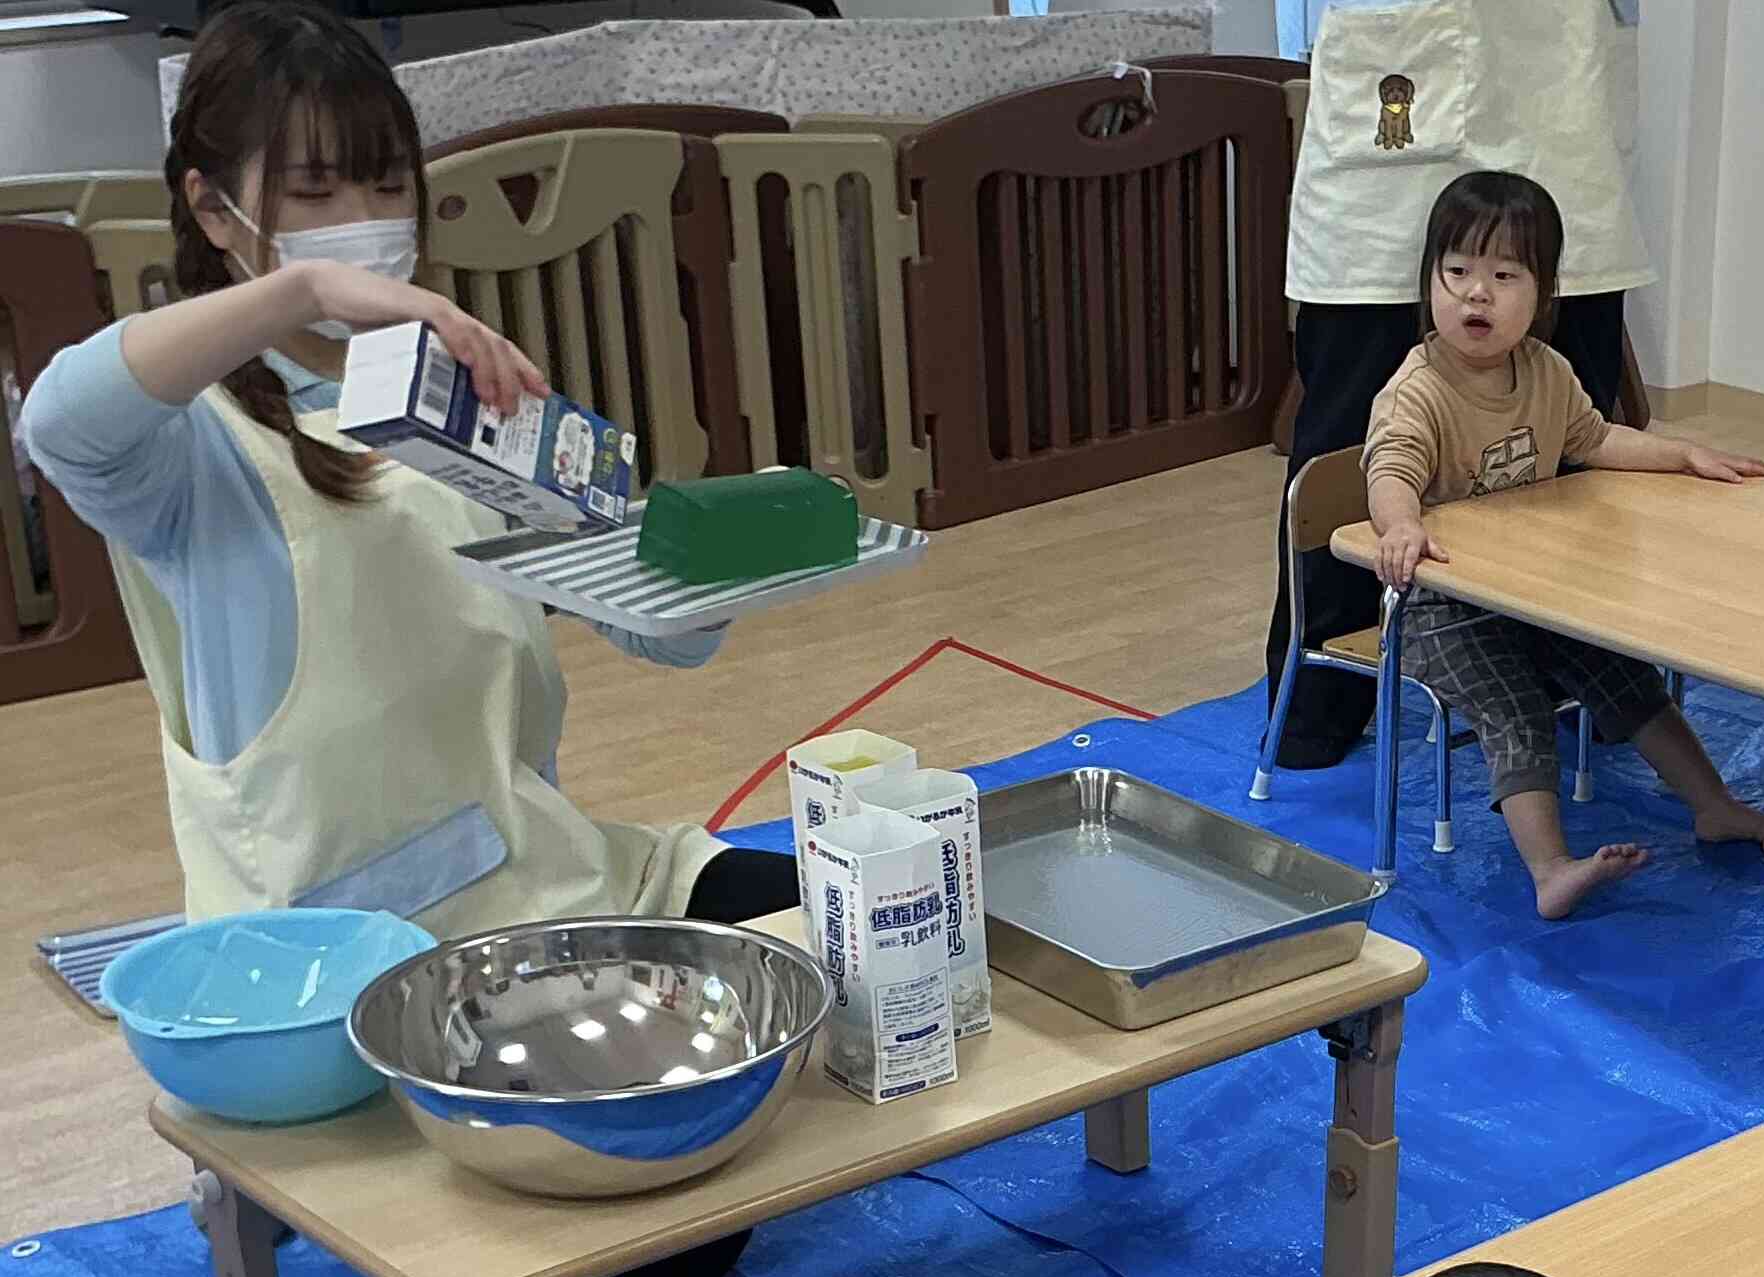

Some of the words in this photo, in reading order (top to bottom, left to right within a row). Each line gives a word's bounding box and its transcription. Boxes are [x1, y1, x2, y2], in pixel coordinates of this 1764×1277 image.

[870, 891, 943, 932] 低脂肪乳
[901, 920, 941, 948] 乳飲料
